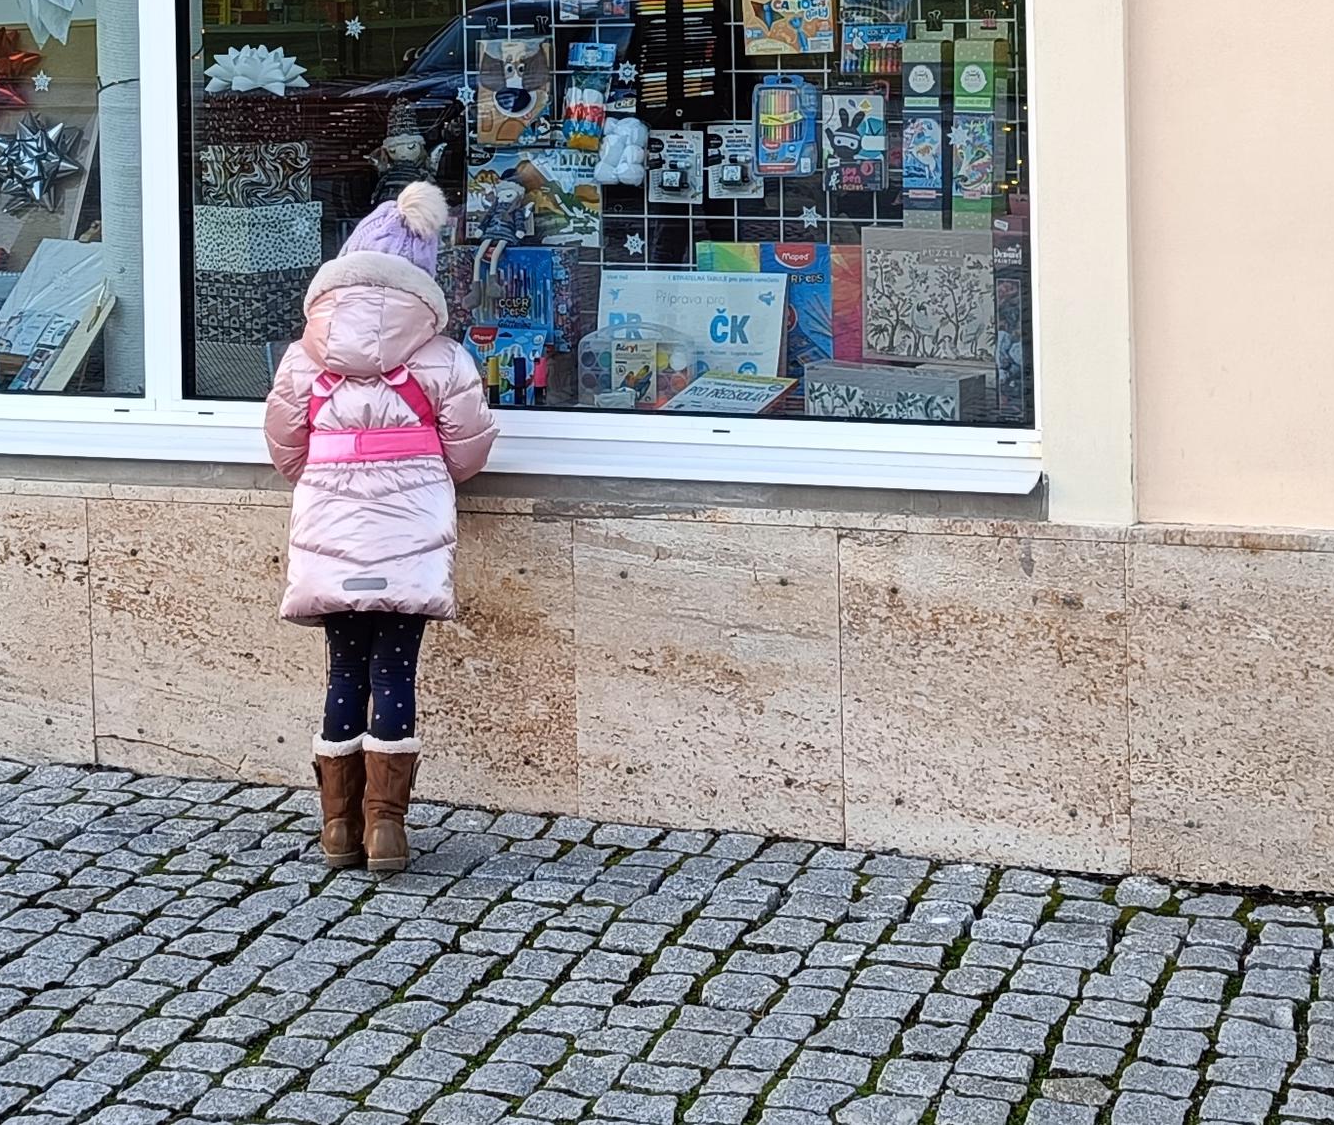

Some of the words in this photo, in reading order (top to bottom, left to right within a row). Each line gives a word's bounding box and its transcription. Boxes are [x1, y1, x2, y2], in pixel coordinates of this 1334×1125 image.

[781, 251, 810, 262] Maped
[498, 297, 529, 309] COLOR
[655, 289, 702, 306] Příprava
[706, 295, 726, 307] pro
[710, 307, 751, 344] ČK
